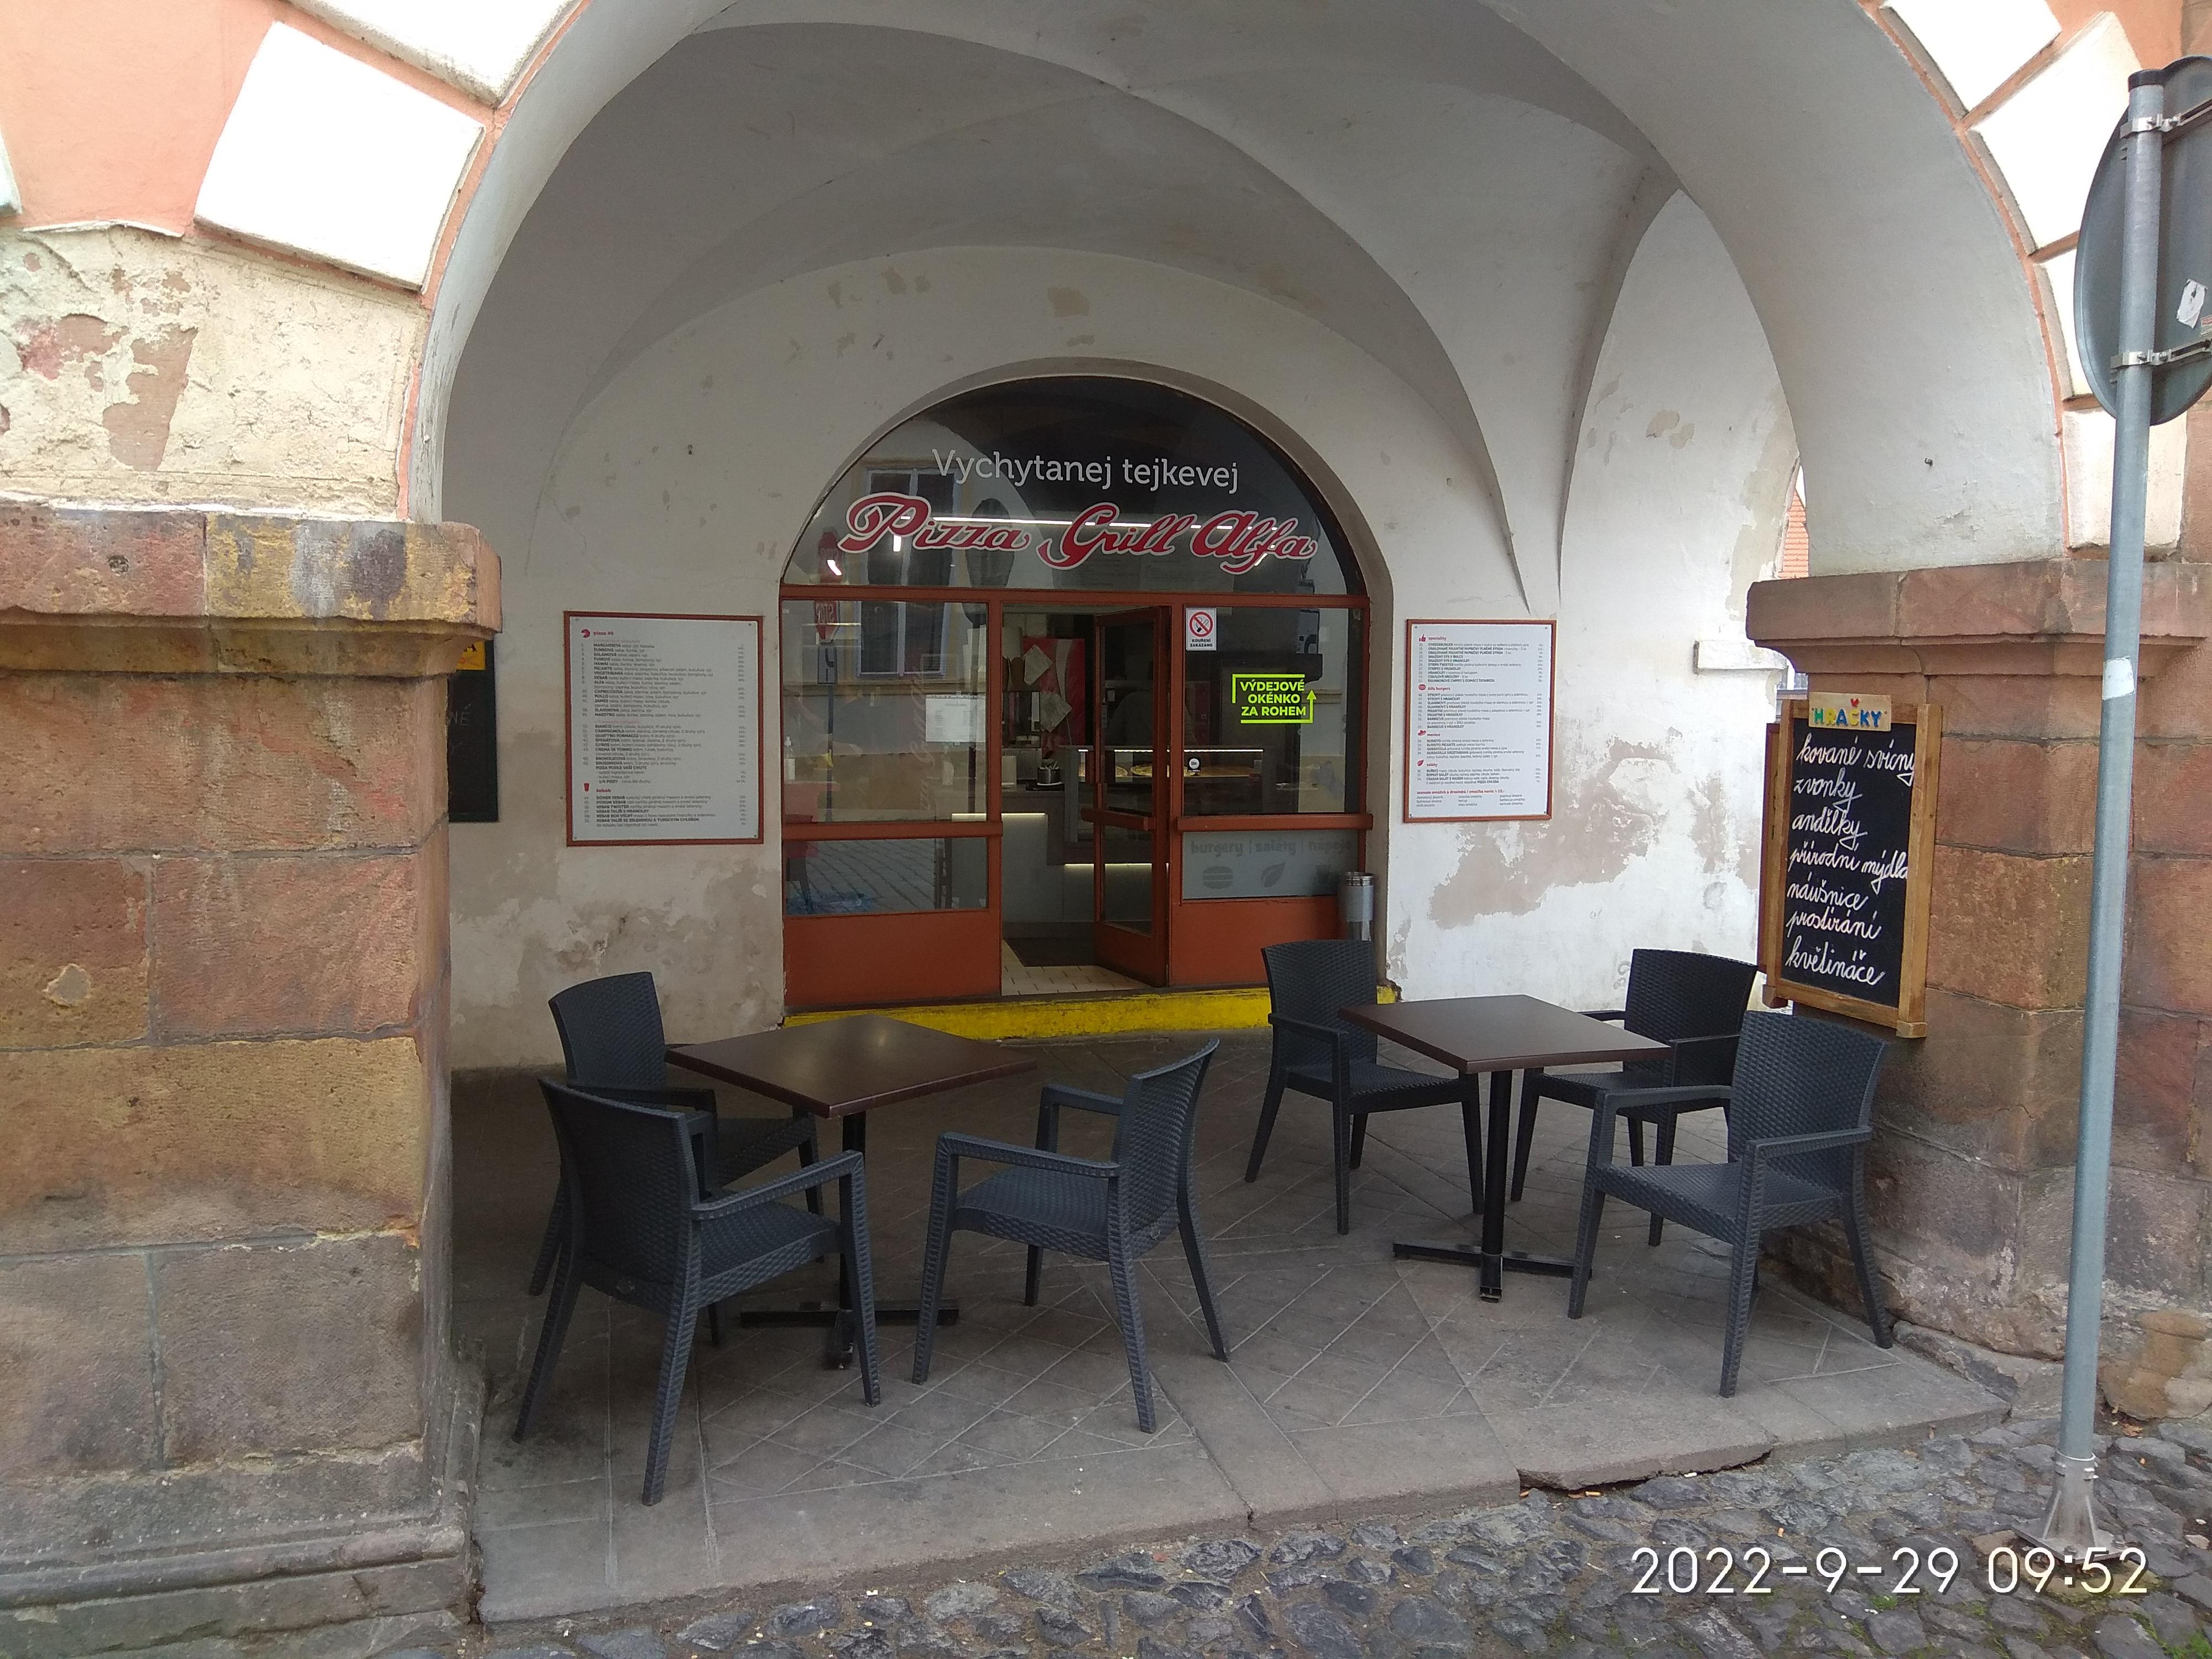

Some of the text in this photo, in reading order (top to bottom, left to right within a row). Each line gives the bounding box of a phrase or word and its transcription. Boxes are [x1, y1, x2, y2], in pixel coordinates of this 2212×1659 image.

[932, 448, 1238, 493] Vychytanej tejkevej
[837, 492, 1317, 575] Pizza Grill Alfa
[1240, 679, 1305, 691] VÝDEJOVÉ
[1248, 692, 1300, 704] OKÉNKO
[1241, 707, 1306, 716] ZA ROHEM
[1813, 698, 1882, 727] HRAČKY
[1796, 732, 1862, 765] kované
[1793, 767, 1863, 810] zvonky
[1792, 806, 1867, 851] andělky
[1191, 840, 1244, 857] burgery
[1255, 839, 1296, 856] saláty
[1787, 841, 1908, 895] přírodní mýdla
[1787, 873, 1869, 911] náušnice
[1784, 936, 1885, 987] květináče
